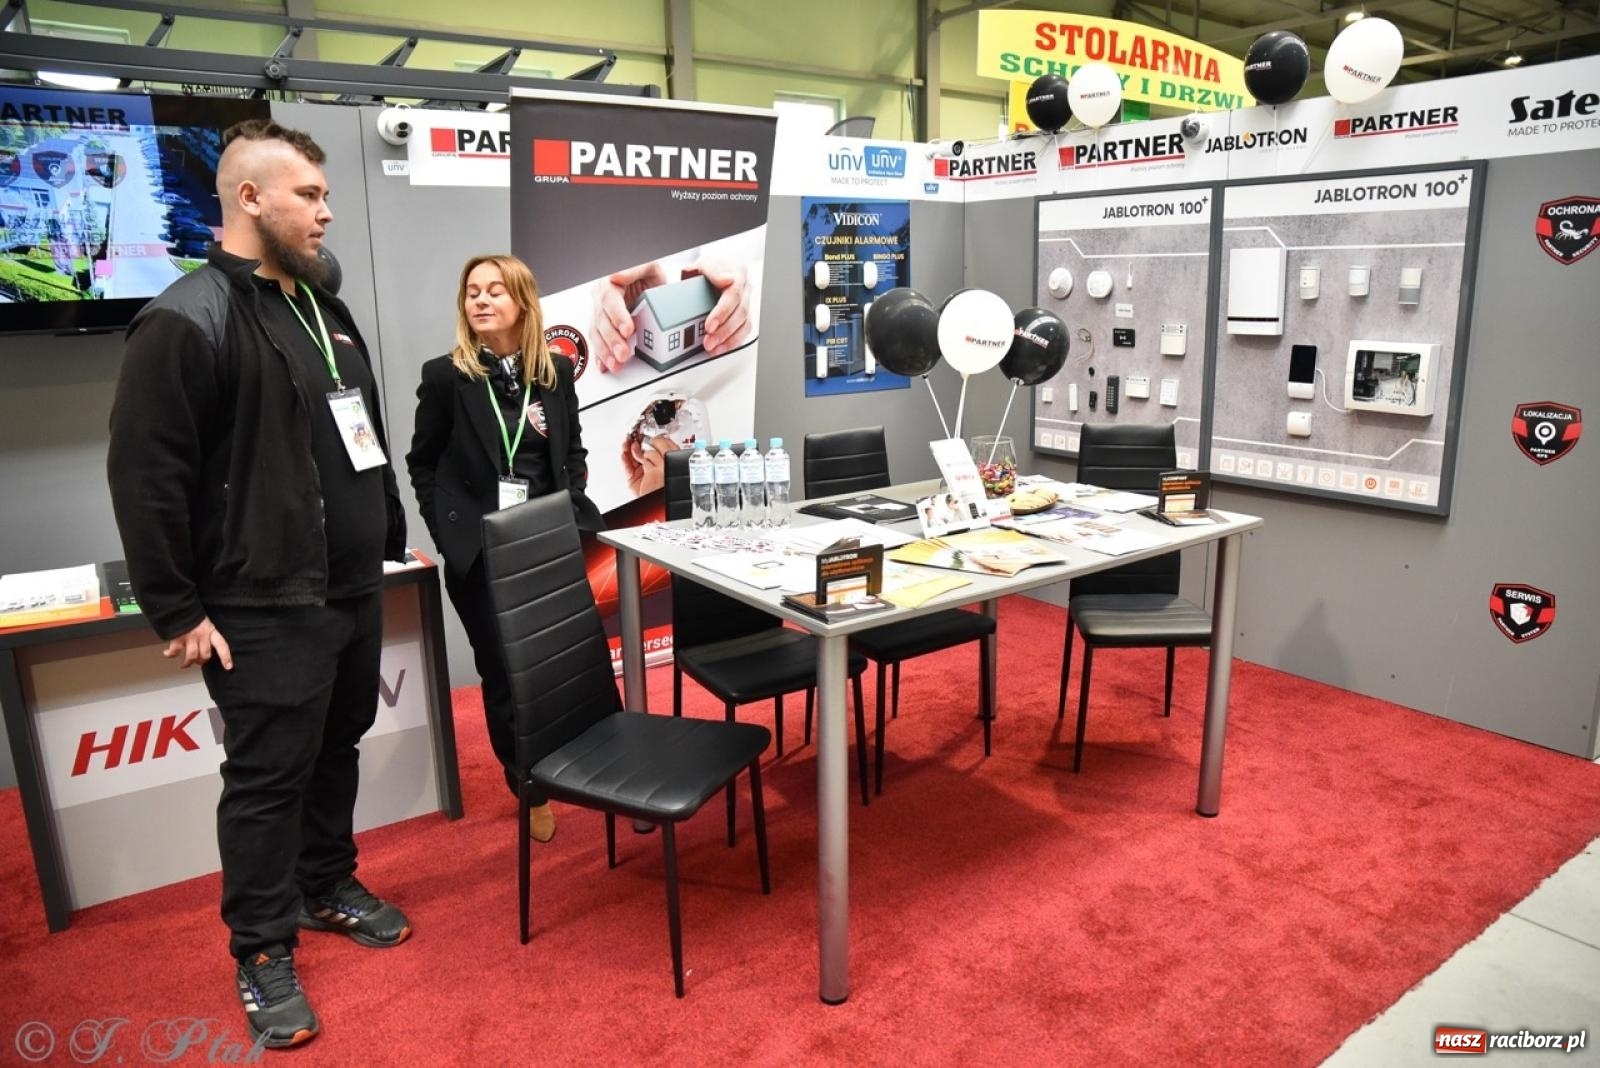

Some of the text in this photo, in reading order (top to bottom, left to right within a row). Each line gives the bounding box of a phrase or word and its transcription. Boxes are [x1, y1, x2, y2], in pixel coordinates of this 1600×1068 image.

[1035, 22, 1221, 84] STOLARNIA
[1000, 53, 1244, 109] SCHY I DRZWI
[0, 102, 129, 126] ARTNER
[1508, 90, 1600, 124] Sate
[1351, 106, 1459, 133] PARTNER
[1507, 119, 1600, 136] MADE TO PROTE
[1075, 133, 1185, 165] PARTNER
[1204, 127, 1308, 154] JABLOTRON
[571, 140, 759, 182] PARTNER
[949, 151, 1037, 177] PARTNER
[535, 176, 570, 184] GRUPA
[831, 177, 850, 185] MADE
[671, 189, 758, 203] Wyższy poziom ochrony
[1314, 183, 1418, 204] JABLOTRON
[833, 212, 880, 226] VIDICON
[1102, 202, 1175, 220] JABLOTRON
[1547, 204, 1600, 216] OCHRONA
[814, 235, 899, 245] CZUJNIKI ALARMOWE
[545, 329, 580, 344] CHRONA
[1523, 410, 1573, 420] LOKALIZACJA
[1505, 589, 1542, 604] SERWIS
